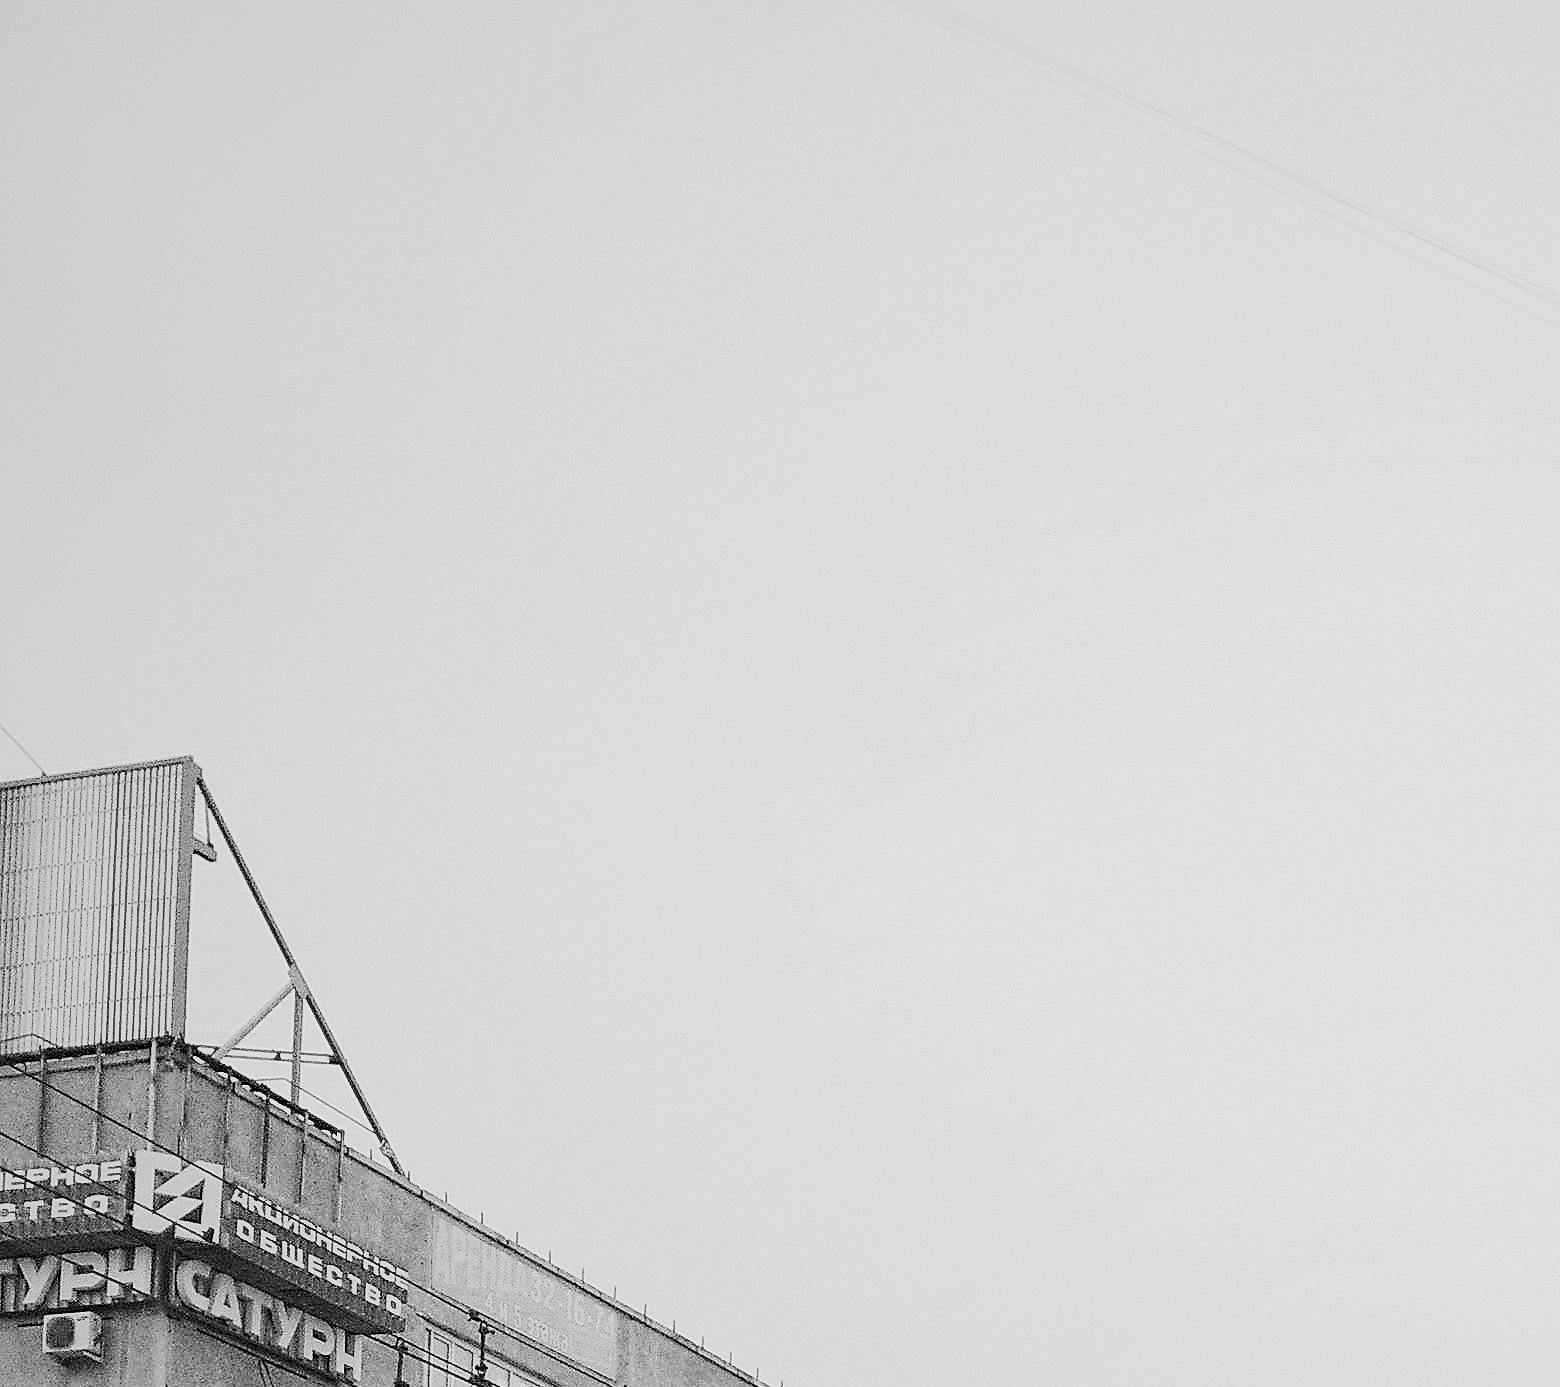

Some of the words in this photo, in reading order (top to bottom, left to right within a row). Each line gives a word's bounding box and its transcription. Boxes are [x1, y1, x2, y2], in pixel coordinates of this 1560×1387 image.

[0, 1160, 121, 1191] ЕРНОЕ
[231, 1186, 409, 1290] АКЦИОНЕРНОЕ
[236, 1219, 403, 1317] ОБЩЕСТВО
[176, 1259, 362, 1381] САТУРН
